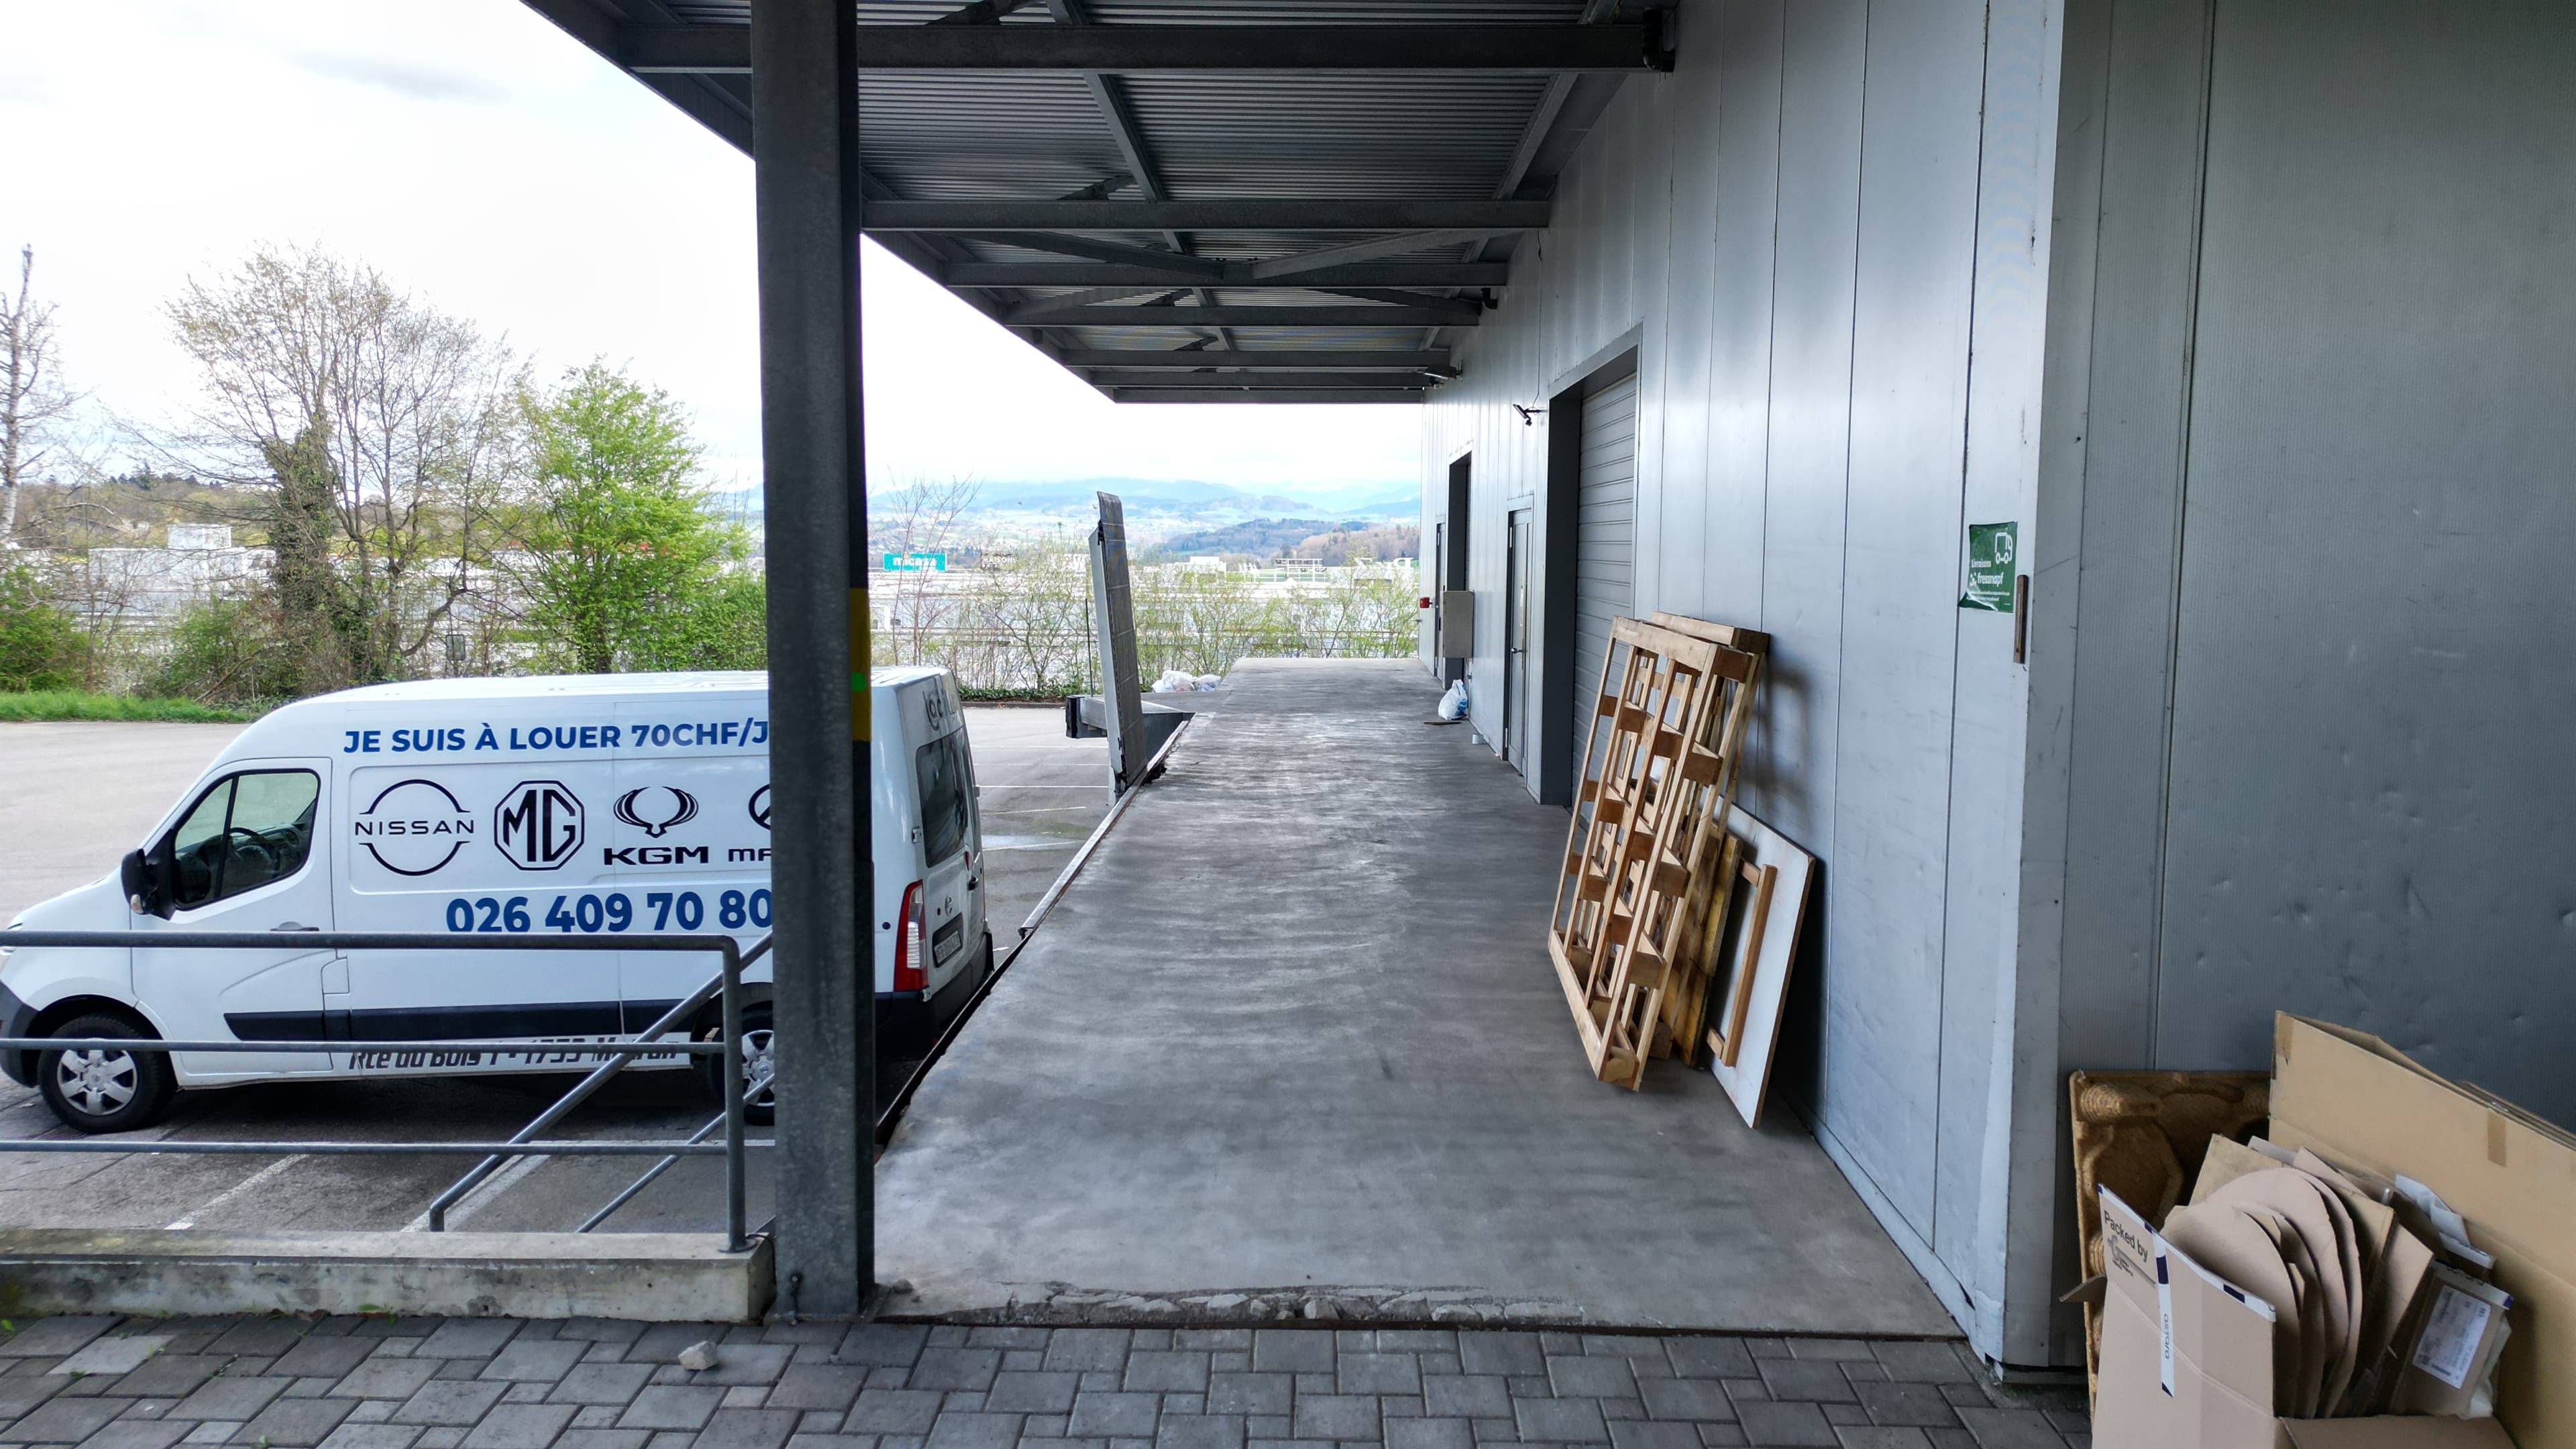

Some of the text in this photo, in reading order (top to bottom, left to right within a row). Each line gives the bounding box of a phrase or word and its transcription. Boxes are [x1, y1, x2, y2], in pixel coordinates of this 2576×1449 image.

[893, 557, 936, 566] micasa
[1977, 572, 2004, 587] fressnapf
[343, 730, 381, 753] JE
[391, 728, 466, 752] SUIS
[474, 722, 499, 751] À
[510, 725, 621, 750] LOUER
[355, 820, 474, 836] NISSAN
[502, 789, 576, 863] MG
[603, 846, 709, 865] KGM
[446, 888, 771, 932] 026 409 70 80
[2104, 1210, 2148, 1263] Packed by
